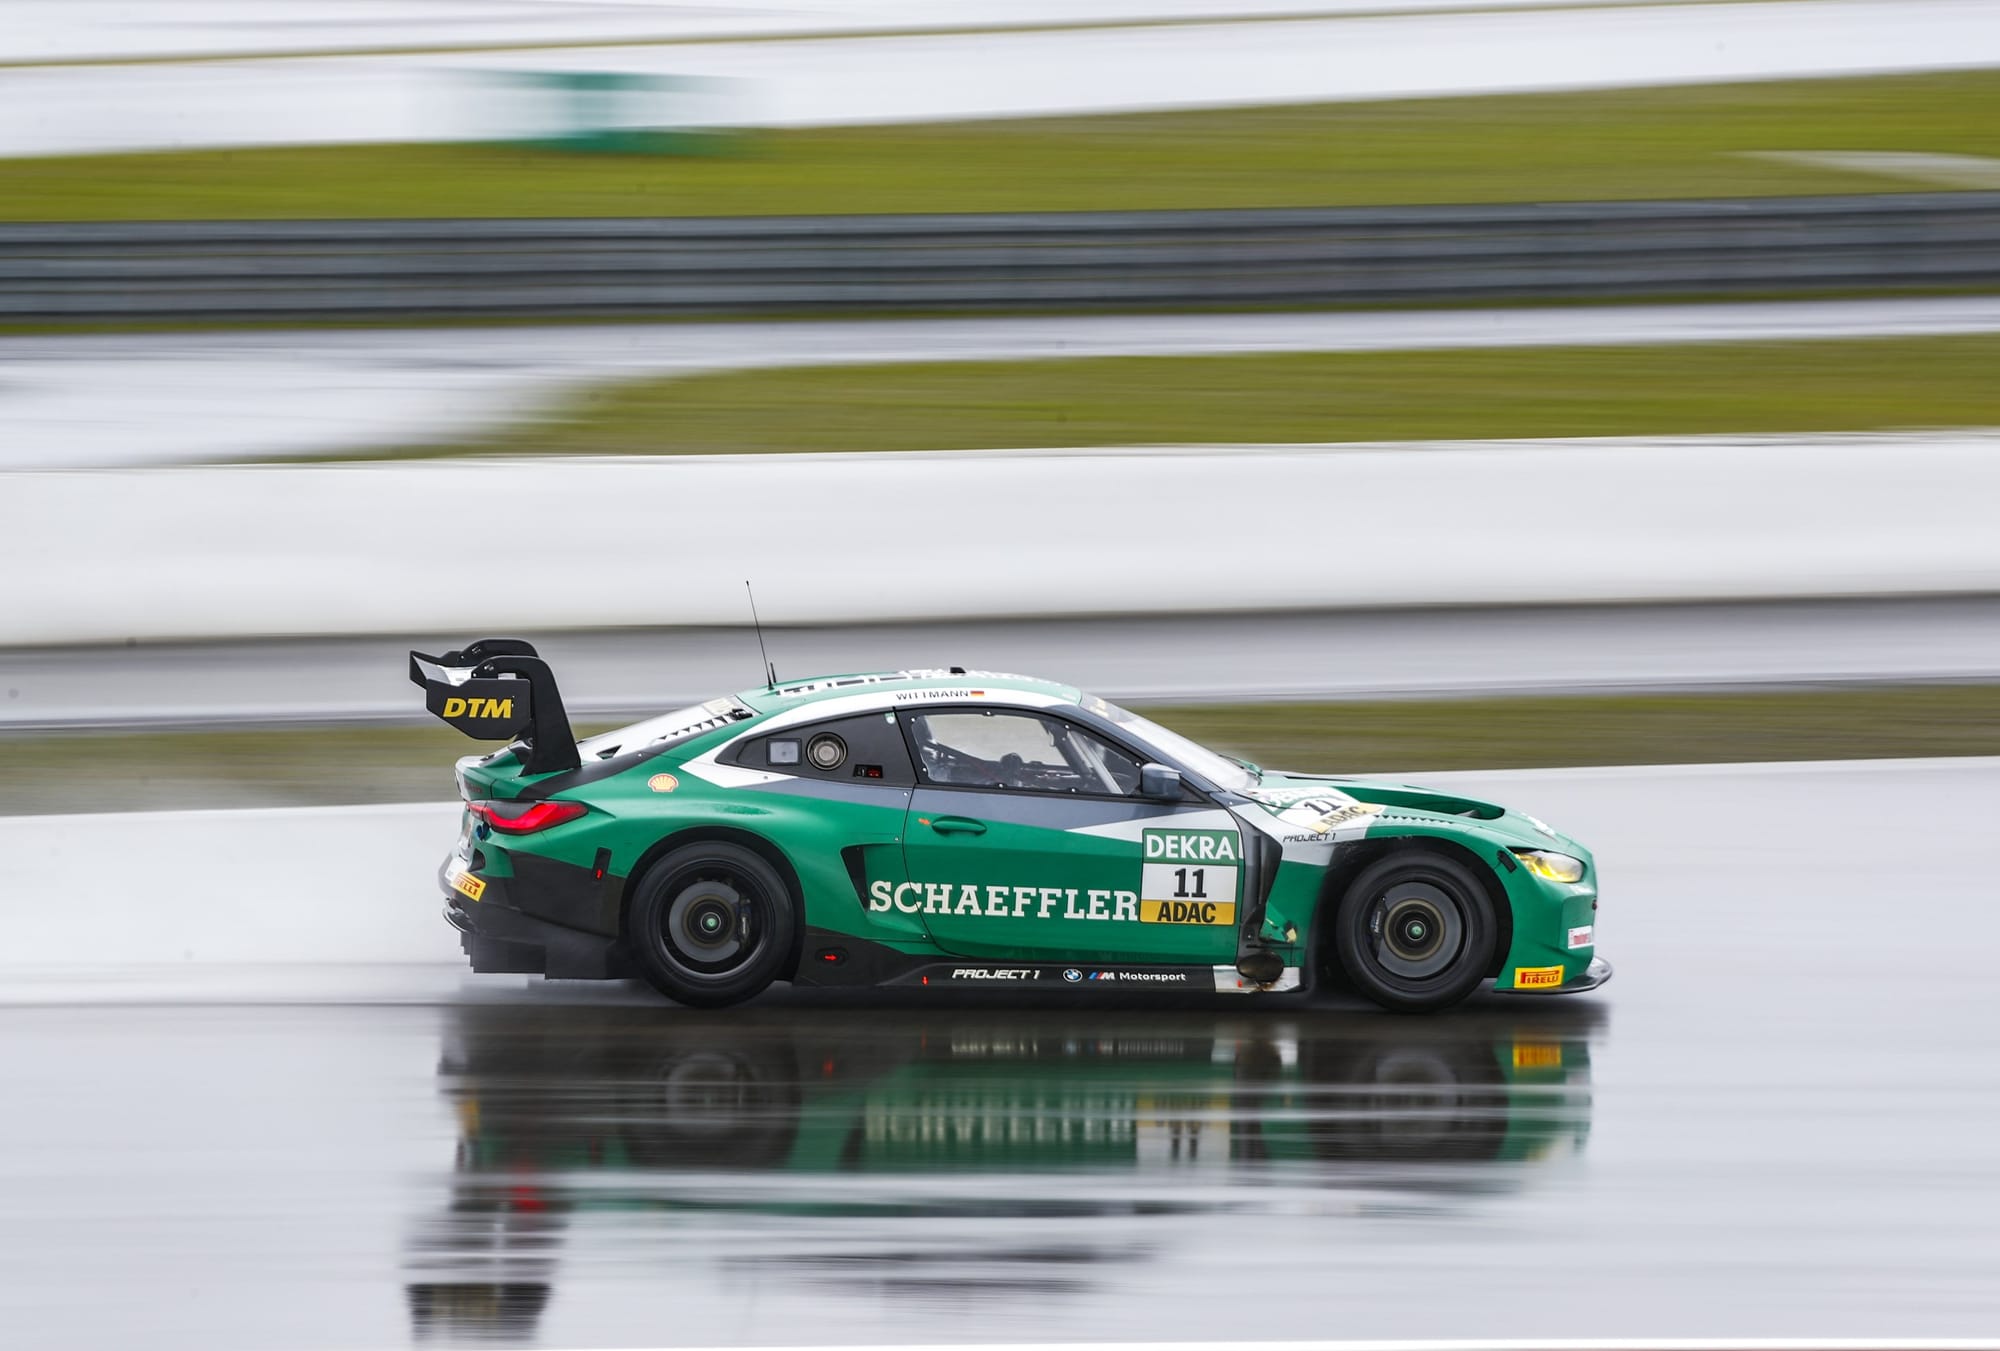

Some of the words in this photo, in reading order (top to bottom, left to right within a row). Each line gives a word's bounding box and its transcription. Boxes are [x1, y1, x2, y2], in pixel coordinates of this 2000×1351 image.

[896, 690, 969, 701] WITTMANN
[443, 697, 512, 719] DTM
[1303, 799, 1342, 816] 11
[1320, 806, 1361, 827] ADAC
[1283, 832, 1331, 842] PROJECT
[1332, 832, 1337, 841] 1
[1146, 834, 1235, 860] DEKRA
[1173, 867, 1207, 898] 11
[869, 880, 1138, 921] SCHAEFFLER
[1157, 901, 1217, 923] ADAC
[952, 968, 1031, 979] PROJECT
[1033, 969, 1041, 979] 1
[1119, 972, 1187, 982] Motorsport
[1520, 969, 1560, 984] PIRELLI
